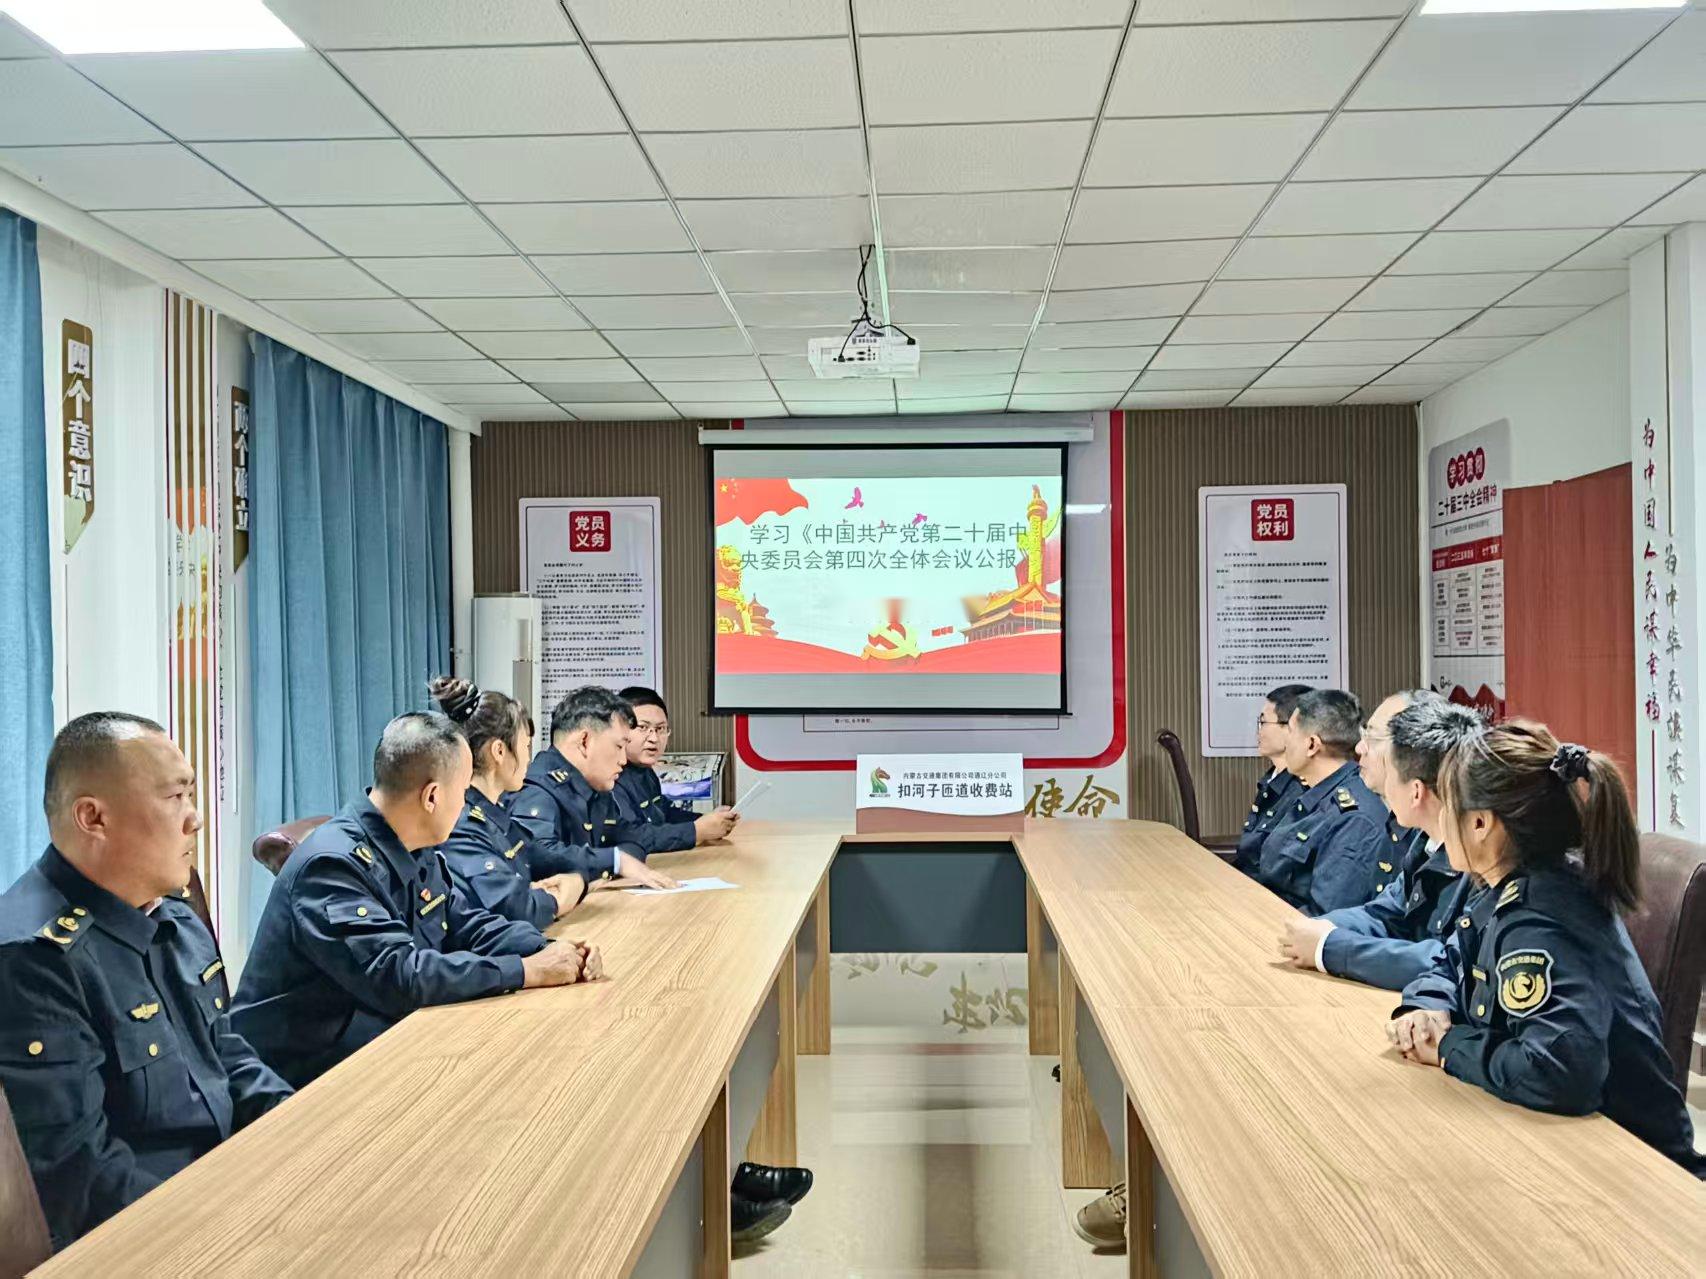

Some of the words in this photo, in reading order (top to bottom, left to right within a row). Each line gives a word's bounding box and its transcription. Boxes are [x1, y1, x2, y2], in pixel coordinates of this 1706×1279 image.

[1256, 504, 1288, 519] 党员
[574, 515, 605, 531] 党员
[1256, 520, 1289, 537] 权利
[575, 532, 605, 548] 义务
[750, 522, 1027, 545] 学习《中国共产党第二十届中
[1643, 418, 1661, 723] 为中国人民谋幸福
[898, 783, 1013, 799] 扣河子匝道收费站
[1024, 774, 1120, 818] 使命
